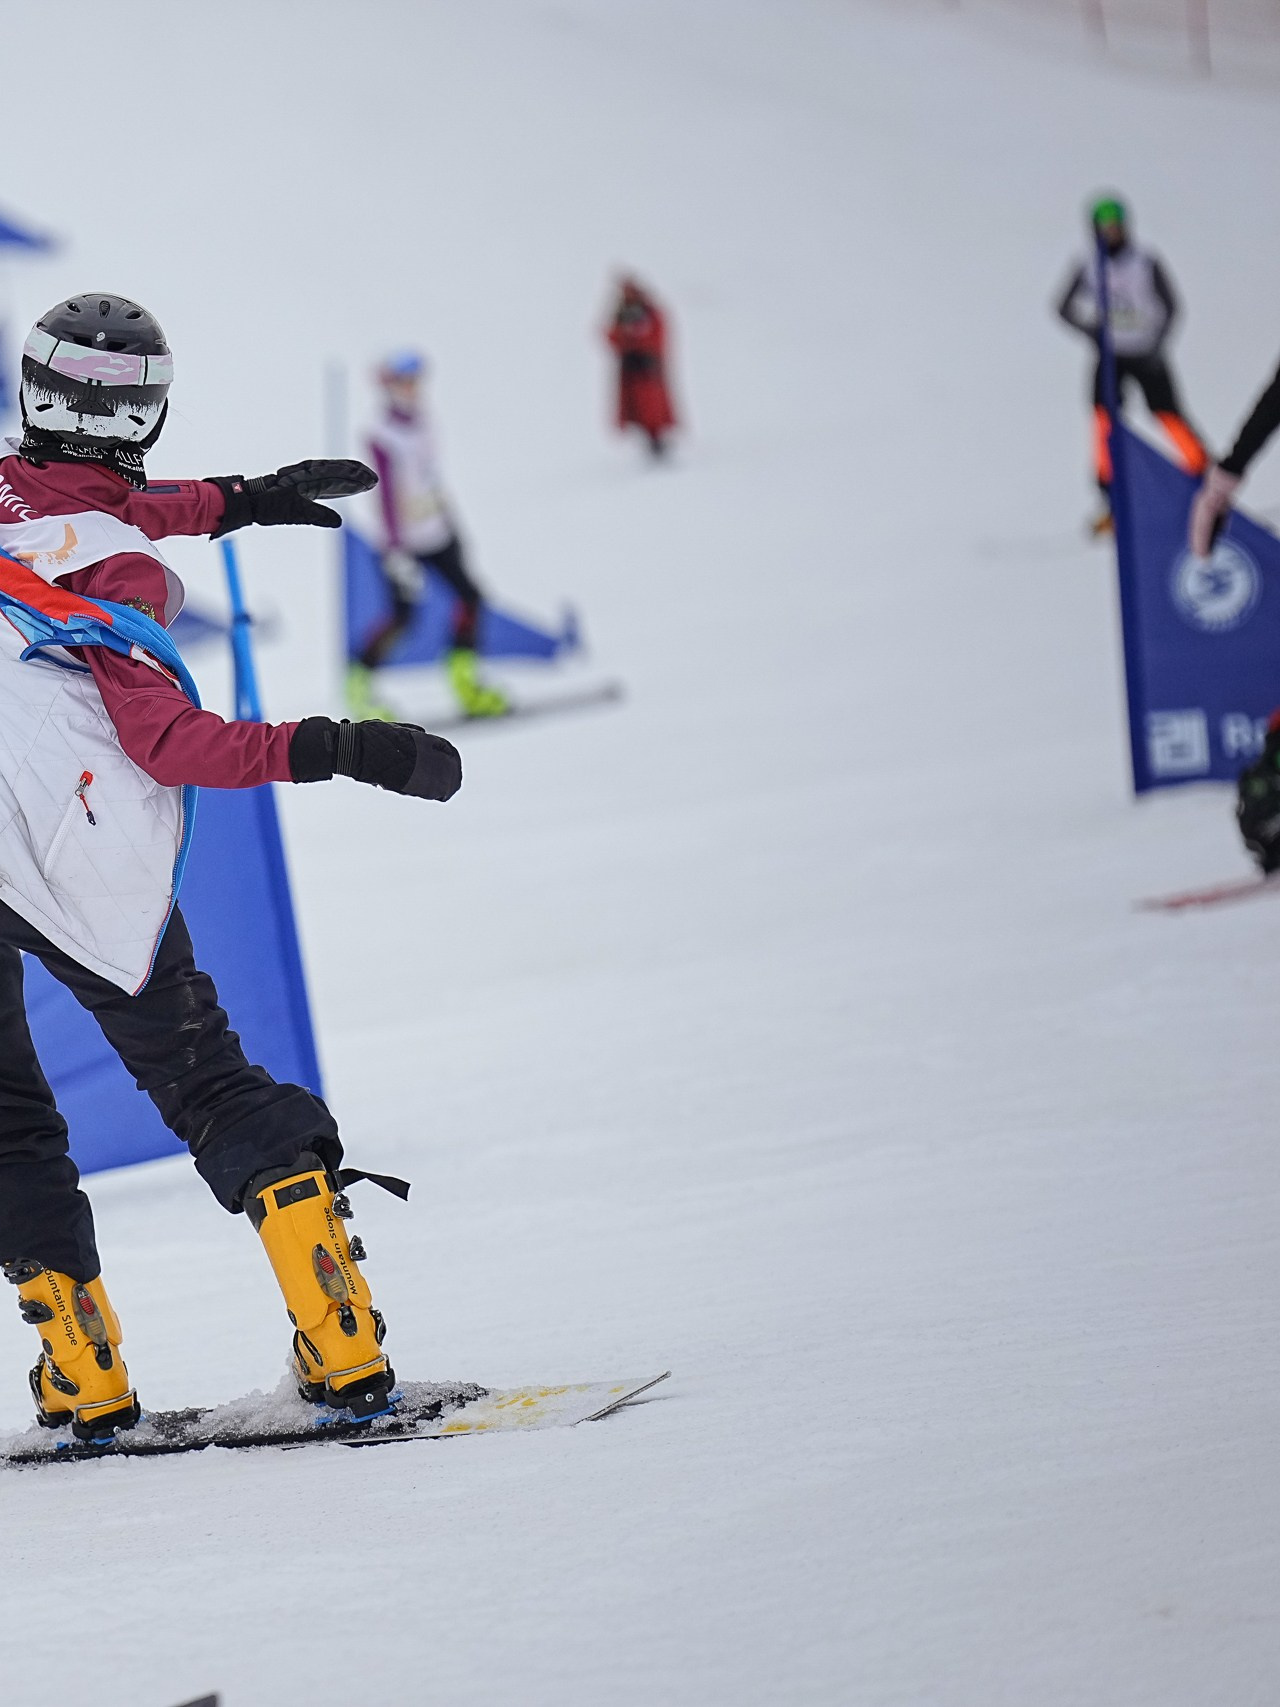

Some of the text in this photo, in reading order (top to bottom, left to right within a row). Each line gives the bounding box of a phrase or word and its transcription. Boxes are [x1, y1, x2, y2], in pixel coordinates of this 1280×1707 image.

[324, 1207, 358, 1295] Mountain Slope
[44, 1268, 78, 1346] ountain Slope
